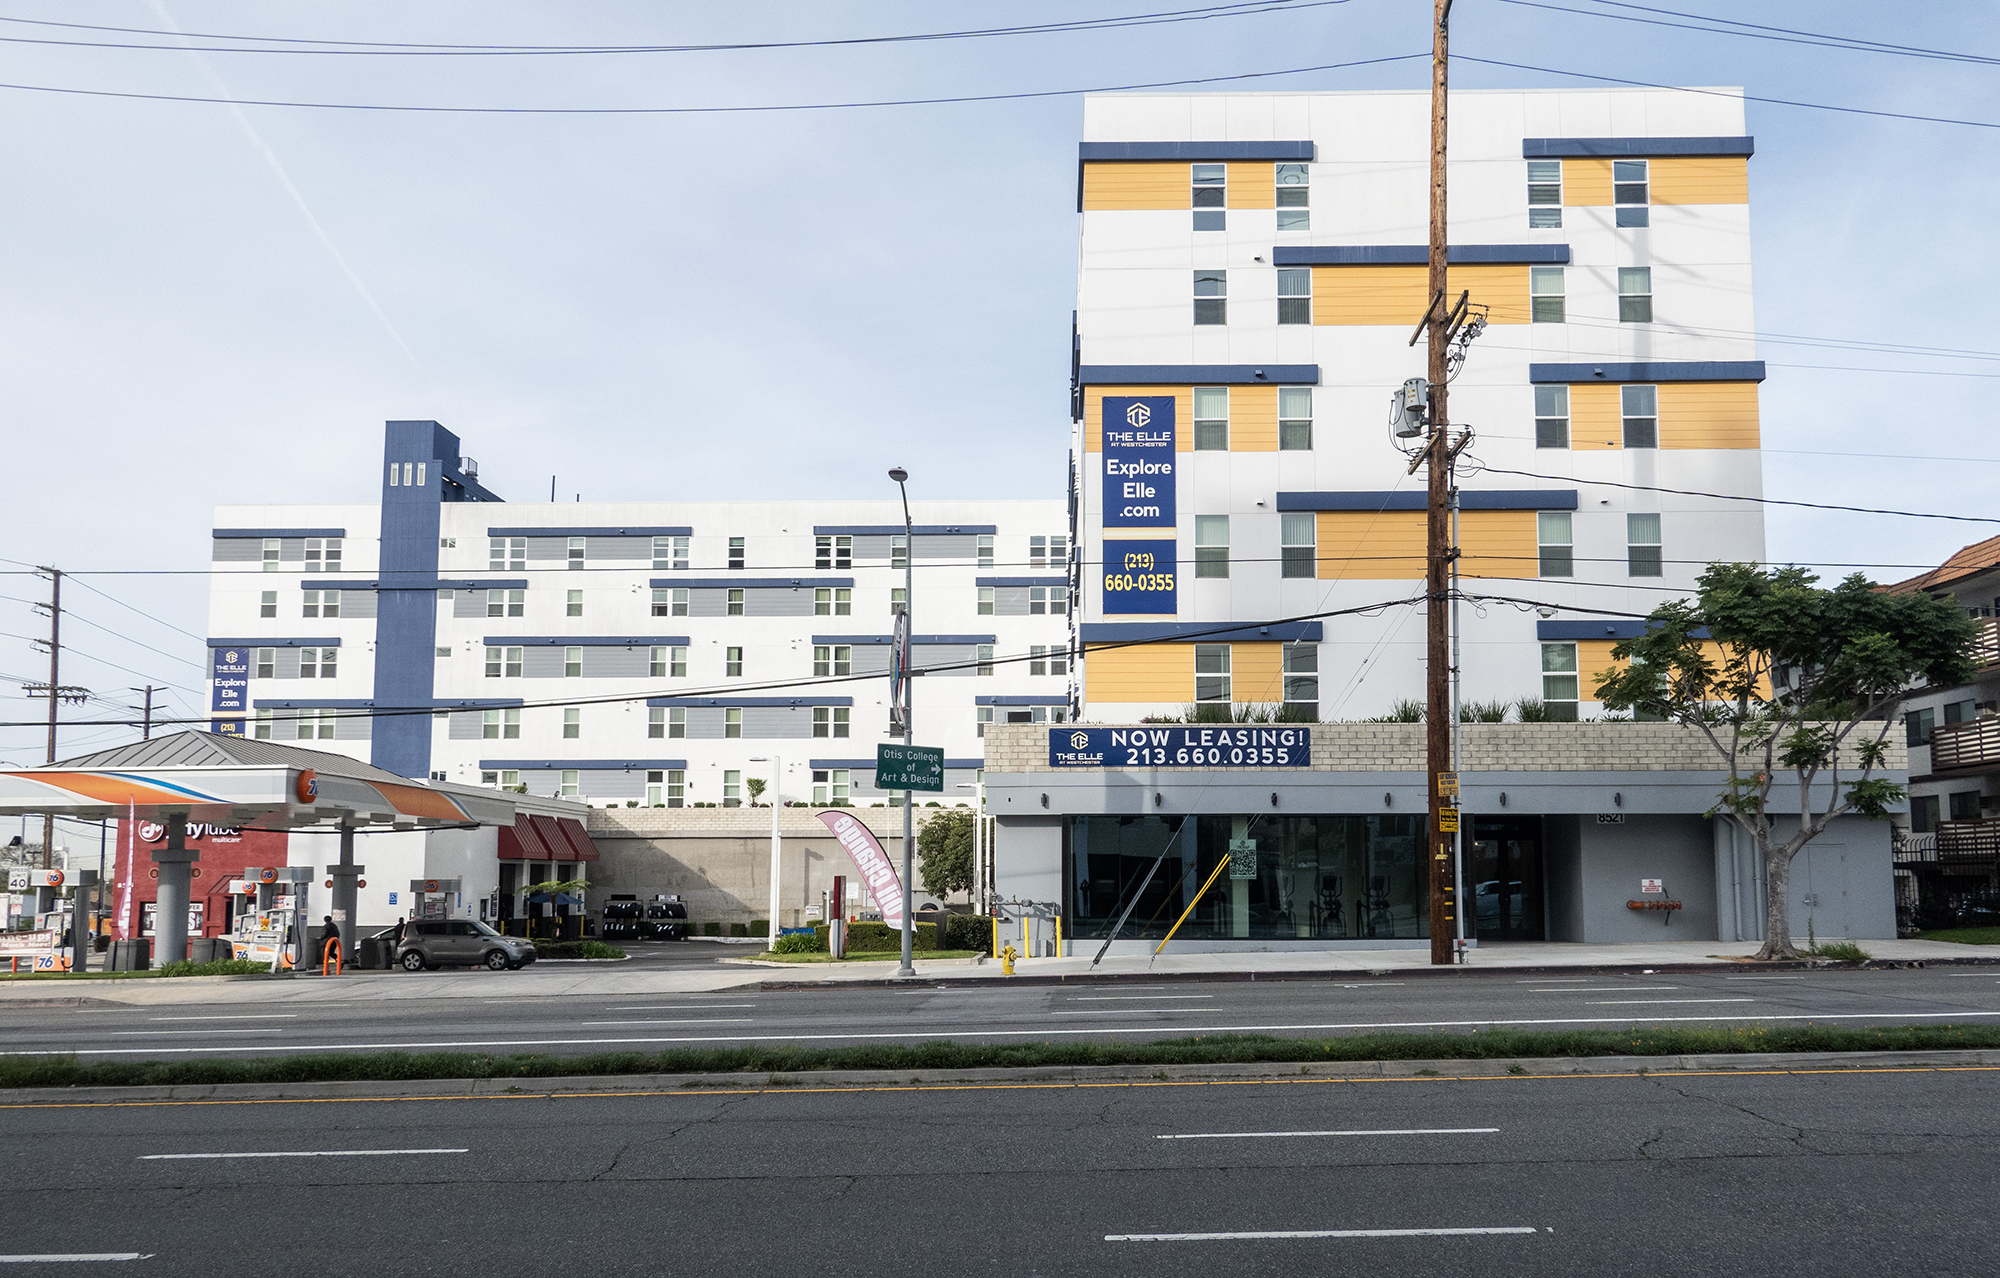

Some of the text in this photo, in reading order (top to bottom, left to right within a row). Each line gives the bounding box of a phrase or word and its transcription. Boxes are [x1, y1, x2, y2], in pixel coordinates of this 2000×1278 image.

[1107, 432, 1171, 441] THE ELLE
[1107, 459, 1172, 478] Explore
[1124, 483, 1156, 498] Elle
[1120, 506, 1159, 517] .com
[1125, 553, 1154, 571] (213)
[1105, 574, 1174, 592] 660-0355
[215, 678, 246, 688] Explore
[222, 690, 238, 698] Elle
[221, 723, 235, 732] (213)
[1112, 730, 1304, 746] NOW LEASING!
[884, 750, 939, 762] Otis College
[1127, 748, 1289, 764] 213.660.0355
[906, 762, 915, 772] of
[881, 772, 940, 786] Art & Design
[1599, 814, 1623, 822] 8521
[49, 873, 59, 882] 76
[262, 871, 273, 879] 76
[10, 879, 26, 888] 40
[236, 950, 248, 960] 76
[38, 955, 54, 968] 76
